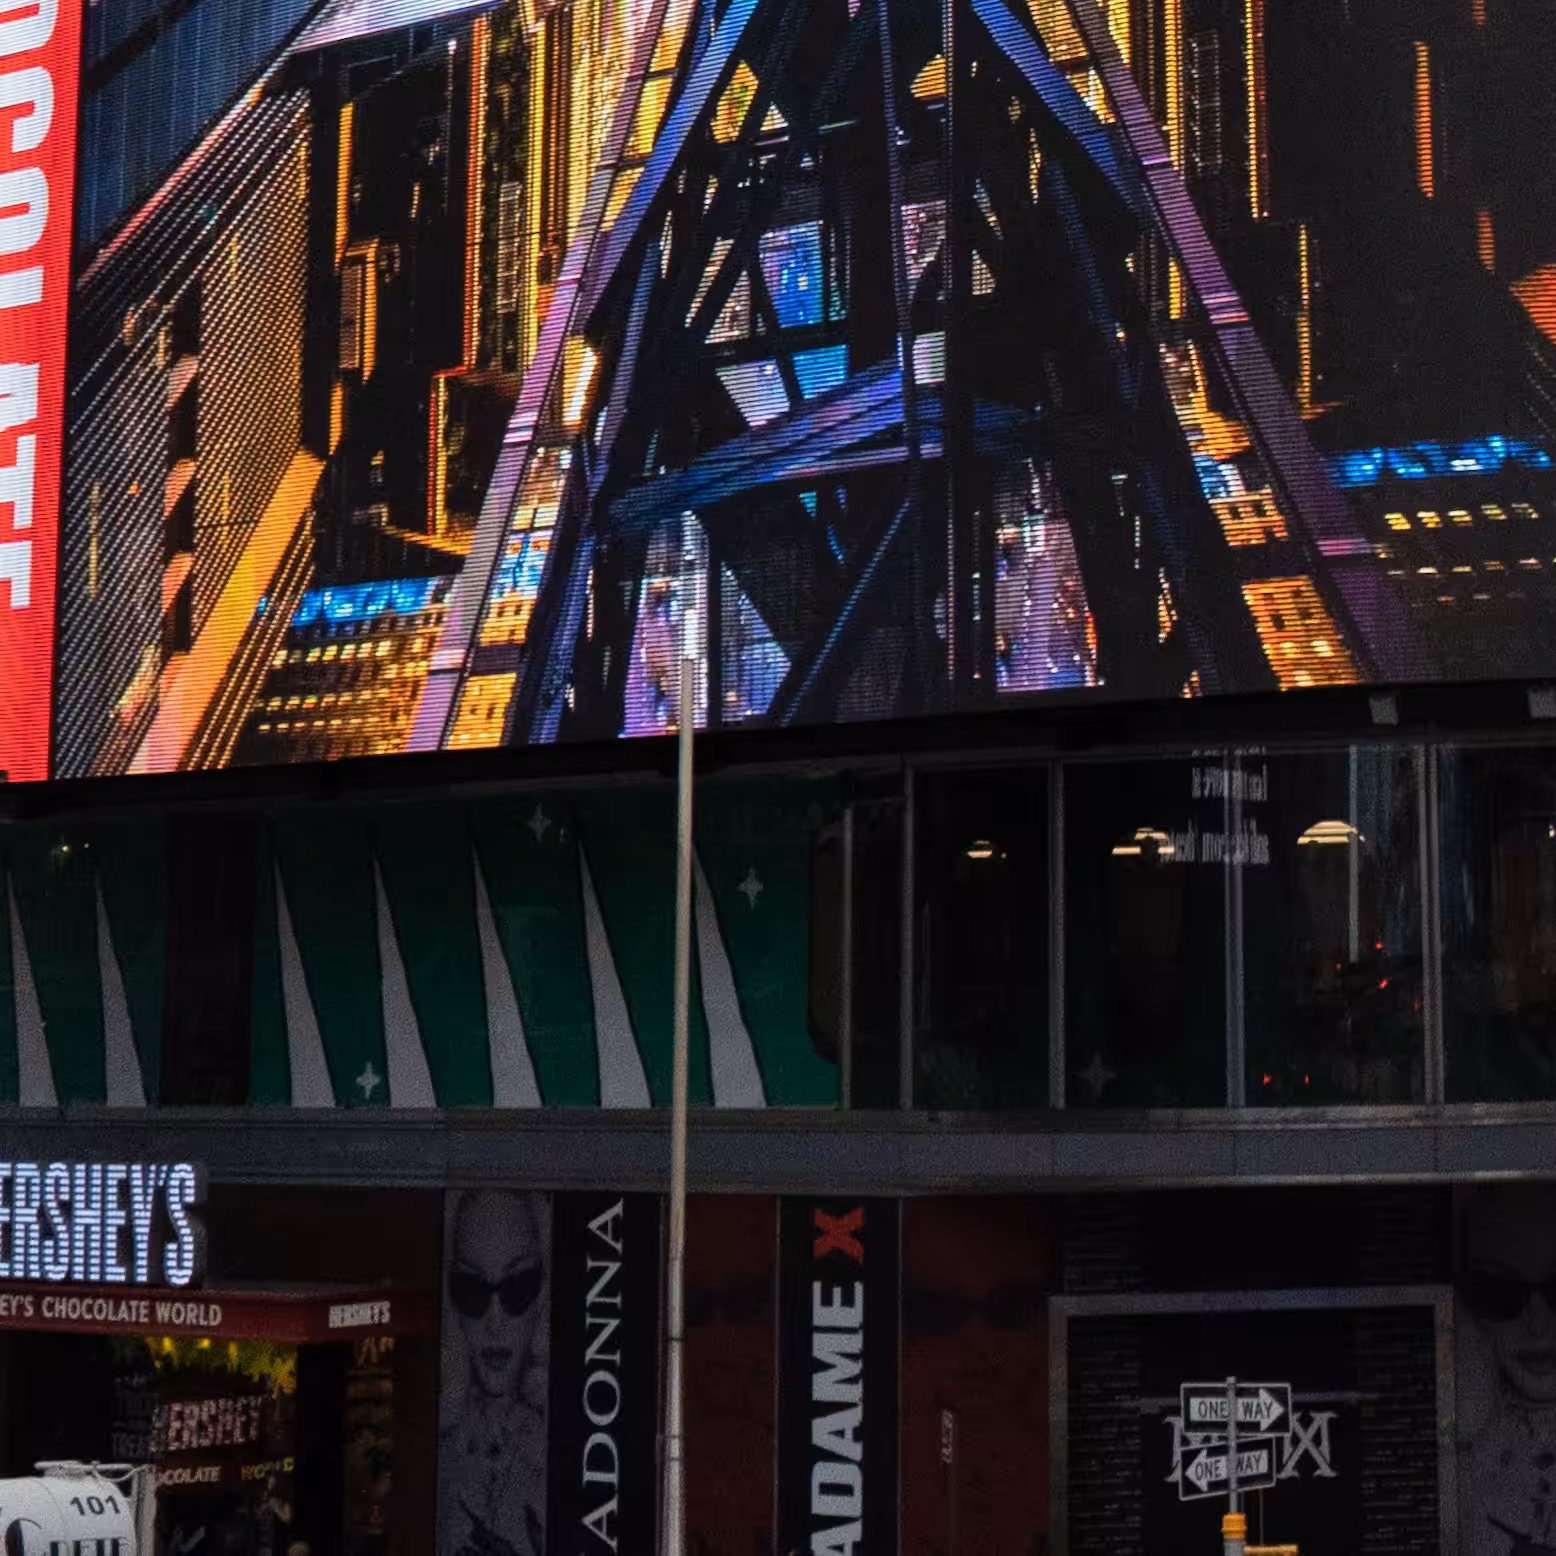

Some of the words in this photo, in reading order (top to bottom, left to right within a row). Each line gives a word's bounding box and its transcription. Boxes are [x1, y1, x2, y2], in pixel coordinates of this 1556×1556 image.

[814, 1206, 865, 1265] X
[42, 1295, 149, 1323] CHOCOLATE
[155, 1301, 222, 1326] WORLD
[581, 1199, 624, 1556] ADONNA
[1199, 1401, 1229, 1419] ONE
[1241, 1399, 1274, 1416] WAY
[1194, 1458, 1222, 1481] ONE
[70, 1495, 120, 1516] 101
